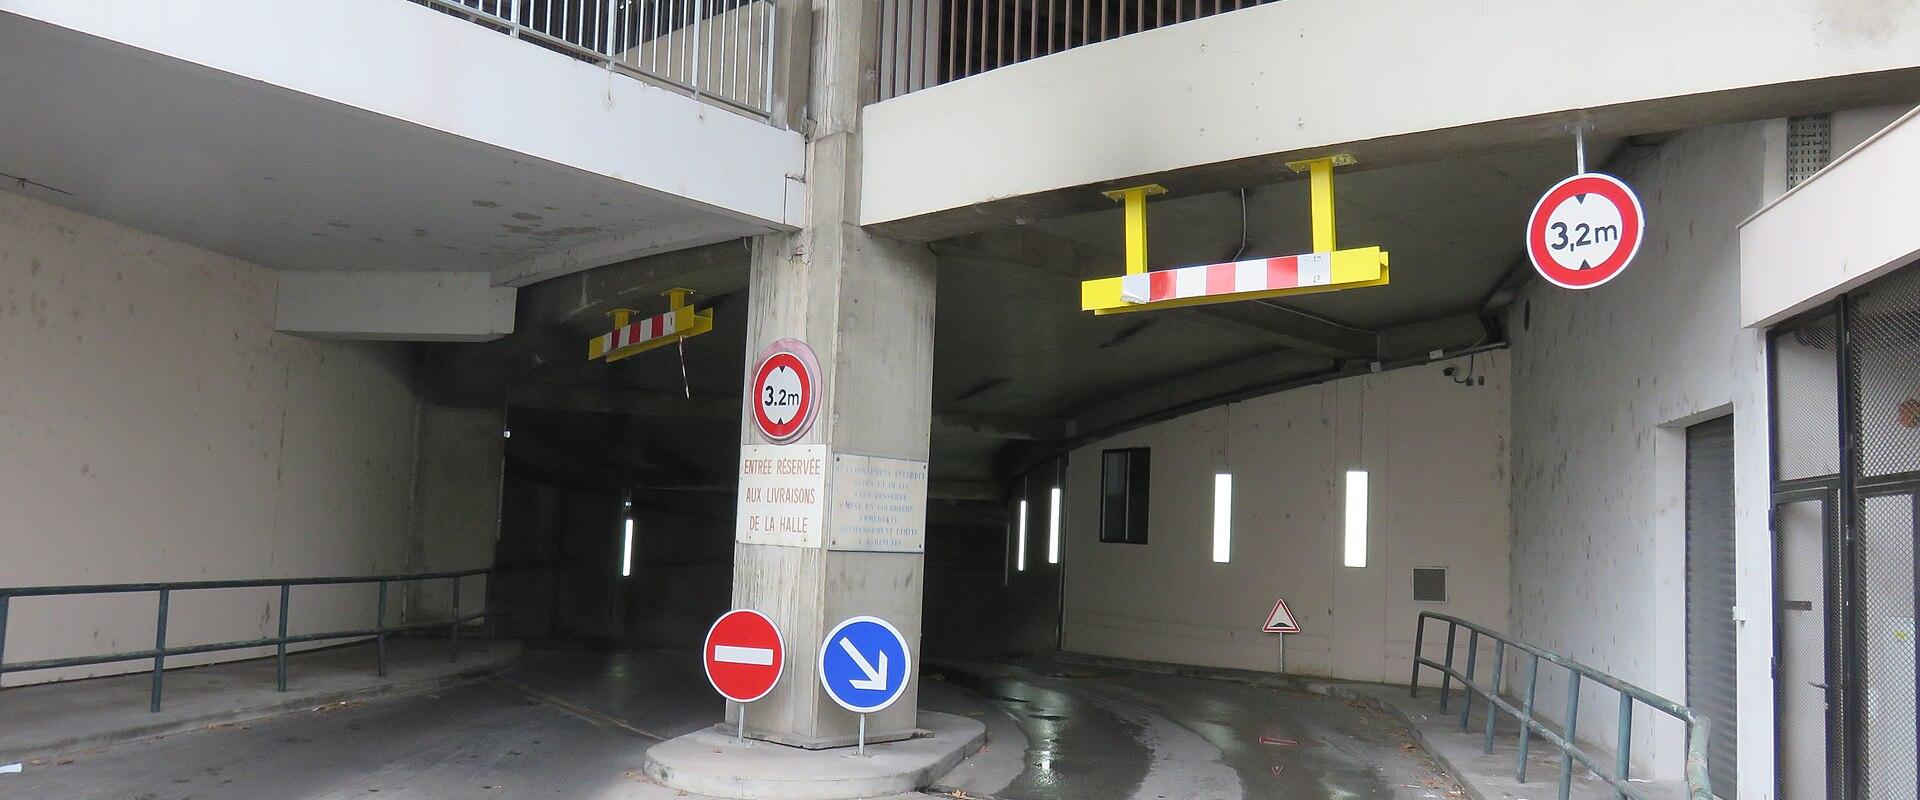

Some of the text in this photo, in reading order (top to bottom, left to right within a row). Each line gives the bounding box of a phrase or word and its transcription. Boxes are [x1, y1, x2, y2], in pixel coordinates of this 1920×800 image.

[1551, 222, 1617, 252] 3,2m
[764, 385, 800, 407] 3.2m
[744, 458, 820, 475] ENTRÉE RÉSERVÉE
[746, 487, 816, 504] AUX LIVRAISONS
[750, 516, 808, 533] DE LA HALLE
